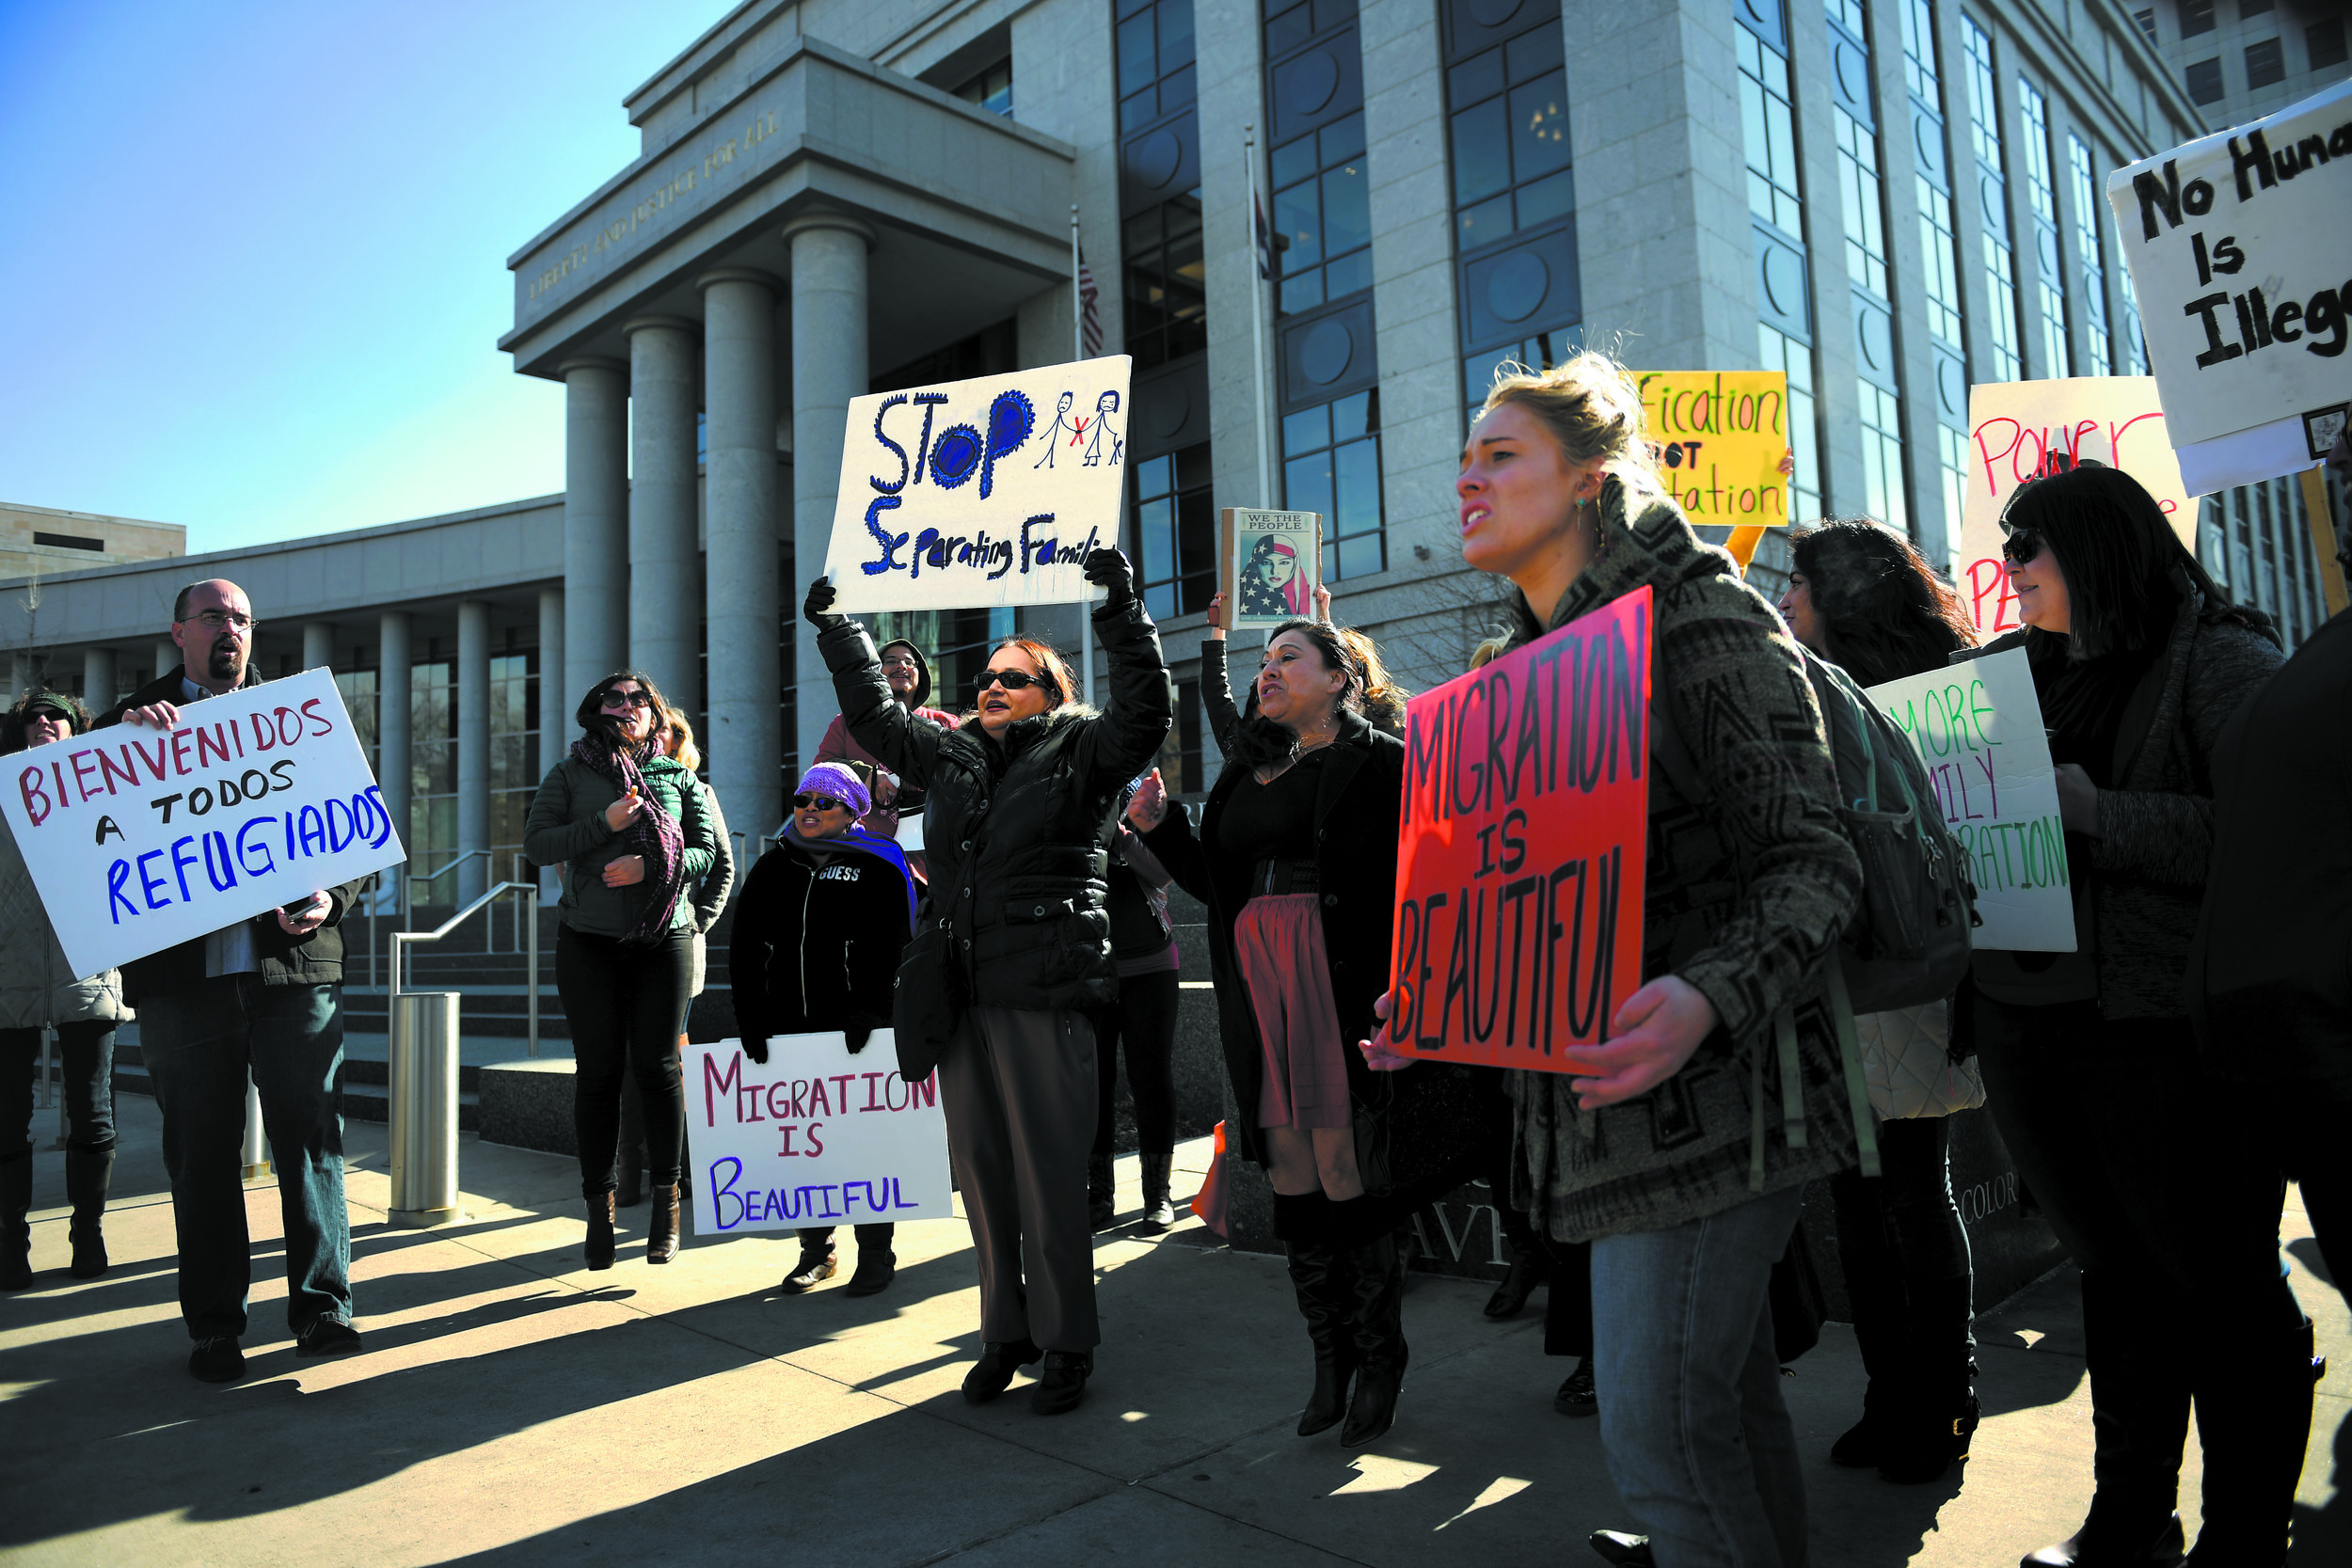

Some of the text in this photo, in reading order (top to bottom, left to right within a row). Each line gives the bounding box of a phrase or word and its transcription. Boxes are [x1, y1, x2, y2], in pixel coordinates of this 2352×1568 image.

[530, 111, 779, 300] LIBERTY AND JUSTICE FOR ALL
[2133, 157, 2215, 243] No
[2191, 231, 2246, 287] Is
[1020, 513, 1100, 574] Famil
[1405, 603, 1645, 825] MIGRATION
[1890, 679, 2002, 760] MORE
[18, 698, 332, 827] BIENVENIDOS
[95, 760, 296, 846] A TODOS
[107, 784, 391, 925] REFUGIADOS
[819, 865, 861, 881] GUESS
[1473, 808, 1527, 880] IS
[1391, 845, 1622, 1056] BEAUTIFUL
[703, 1051, 936, 1127] MIGRATION
[778, 1122, 824, 1158] IS
[709, 1156, 919, 1229] BEAUTIFUL
